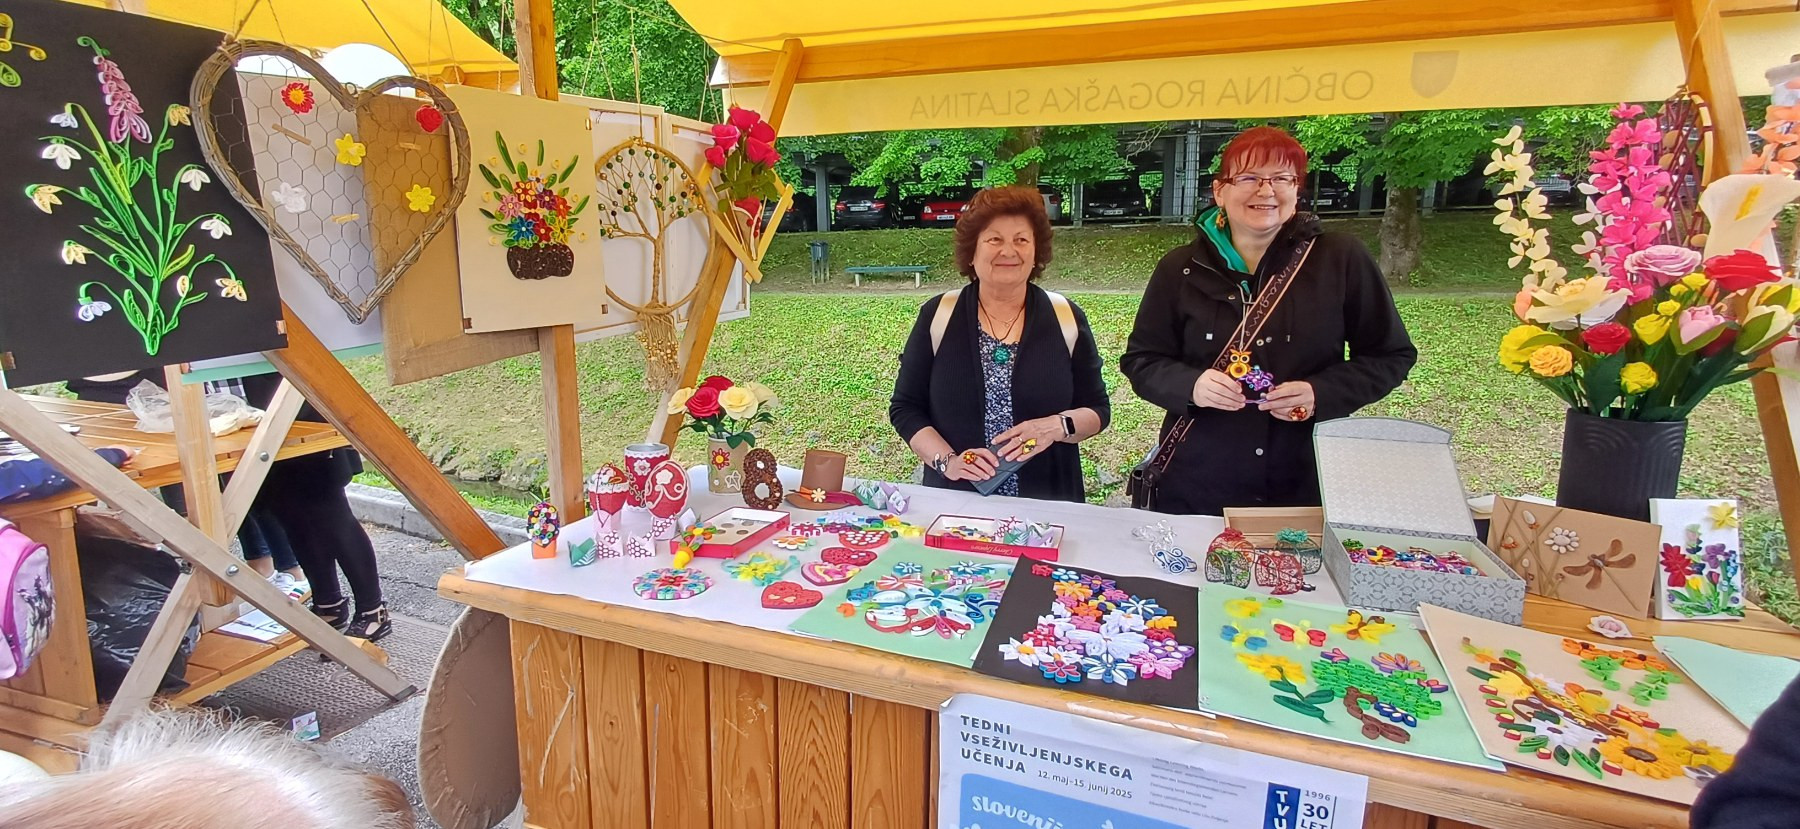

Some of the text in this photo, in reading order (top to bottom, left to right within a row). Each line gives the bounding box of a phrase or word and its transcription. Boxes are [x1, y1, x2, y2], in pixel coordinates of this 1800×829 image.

[960, 715, 1010, 735] TEDNI
[960, 731, 1133, 781] VSEŽIVLJENJSKEGA
[961, 748, 1026, 774] UČENJA
[1088, 782, 1109, 796] junij
[1110, 787, 1133, 799] 2025
[1304, 790, 1331, 801] 1996
[1303, 803, 1329, 820] 30
